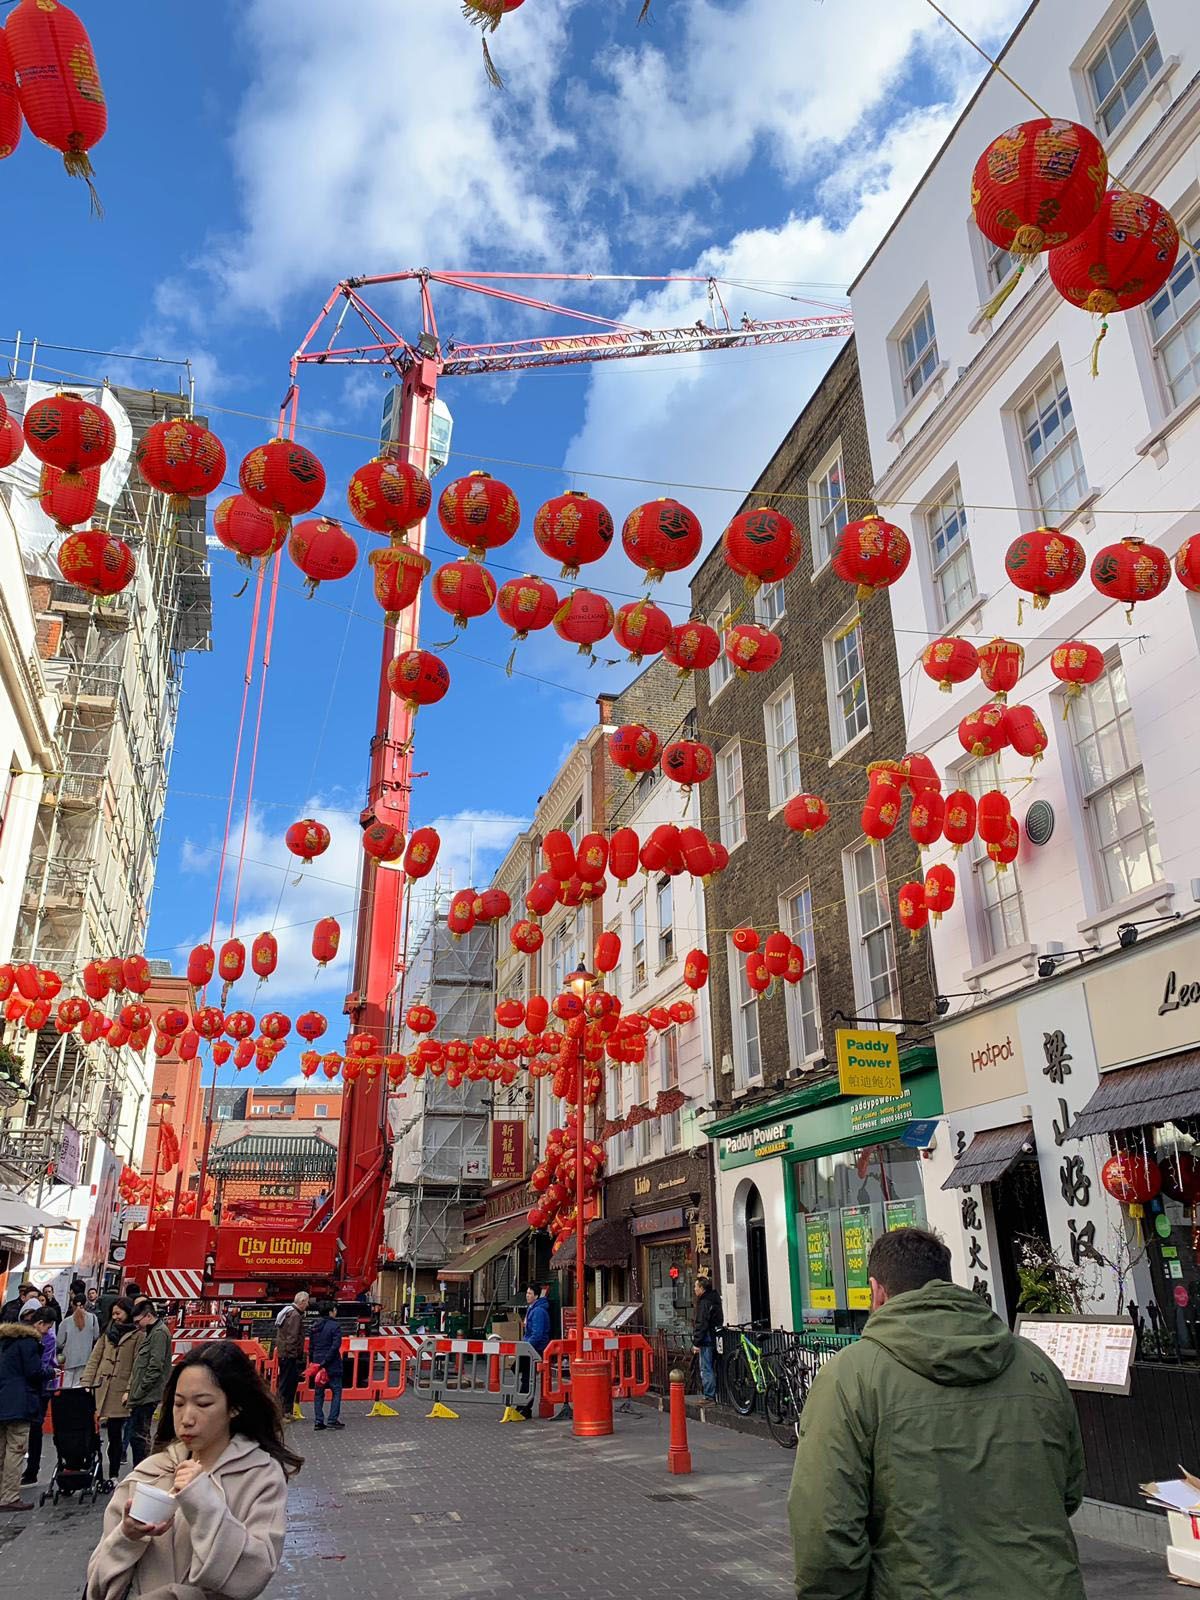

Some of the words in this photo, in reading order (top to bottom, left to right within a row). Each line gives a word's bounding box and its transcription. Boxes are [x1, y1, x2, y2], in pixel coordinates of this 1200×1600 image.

[846, 1038, 889, 1053] Paddy
[847, 1056, 892, 1068] Power
[852, 1119, 878, 1131] FREEPHONE
[726, 1132, 753, 1153] Paddy
[752, 1124, 785, 1146] Power
[239, 1237, 267, 1256] City
